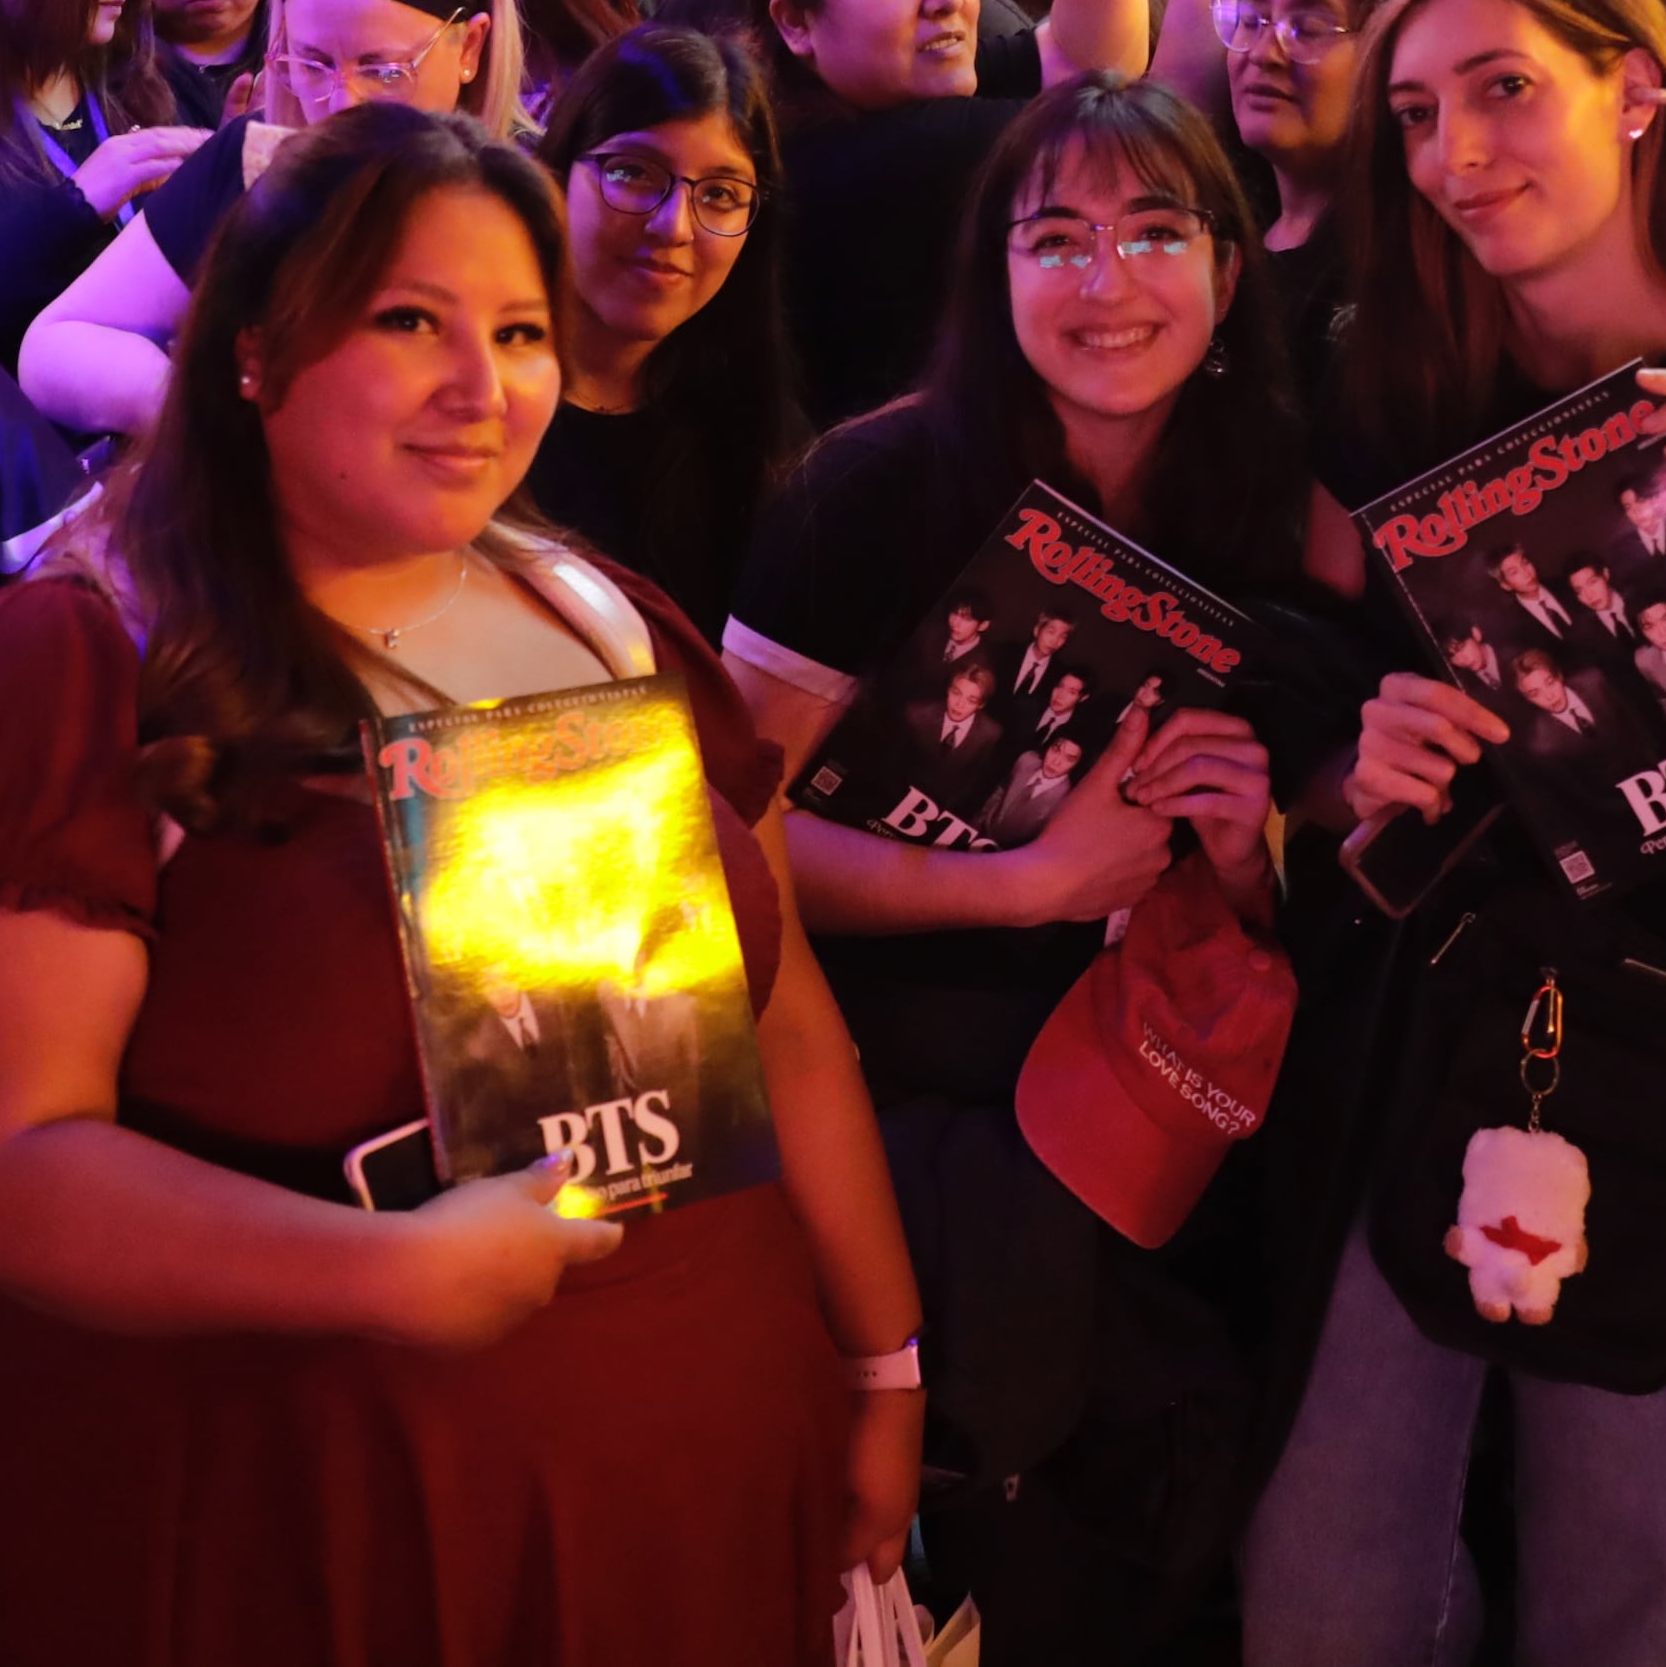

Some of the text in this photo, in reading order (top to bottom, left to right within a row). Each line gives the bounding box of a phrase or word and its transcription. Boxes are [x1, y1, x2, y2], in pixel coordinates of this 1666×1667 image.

[1389, 474, 1454, 514] ESPECIAL
[1457, 453, 1493, 477] PARA
[1496, 389, 1612, 456] COLECCIONISTAS
[1113, 547, 1142, 569] PARA
[1138, 1039, 1241, 1135] LOVE SONG?
[1142, 1021, 1257, 1128] WHAT IS YOUR
[536, 1088, 681, 1185] BTS
[607, 1176, 642, 1202] para
